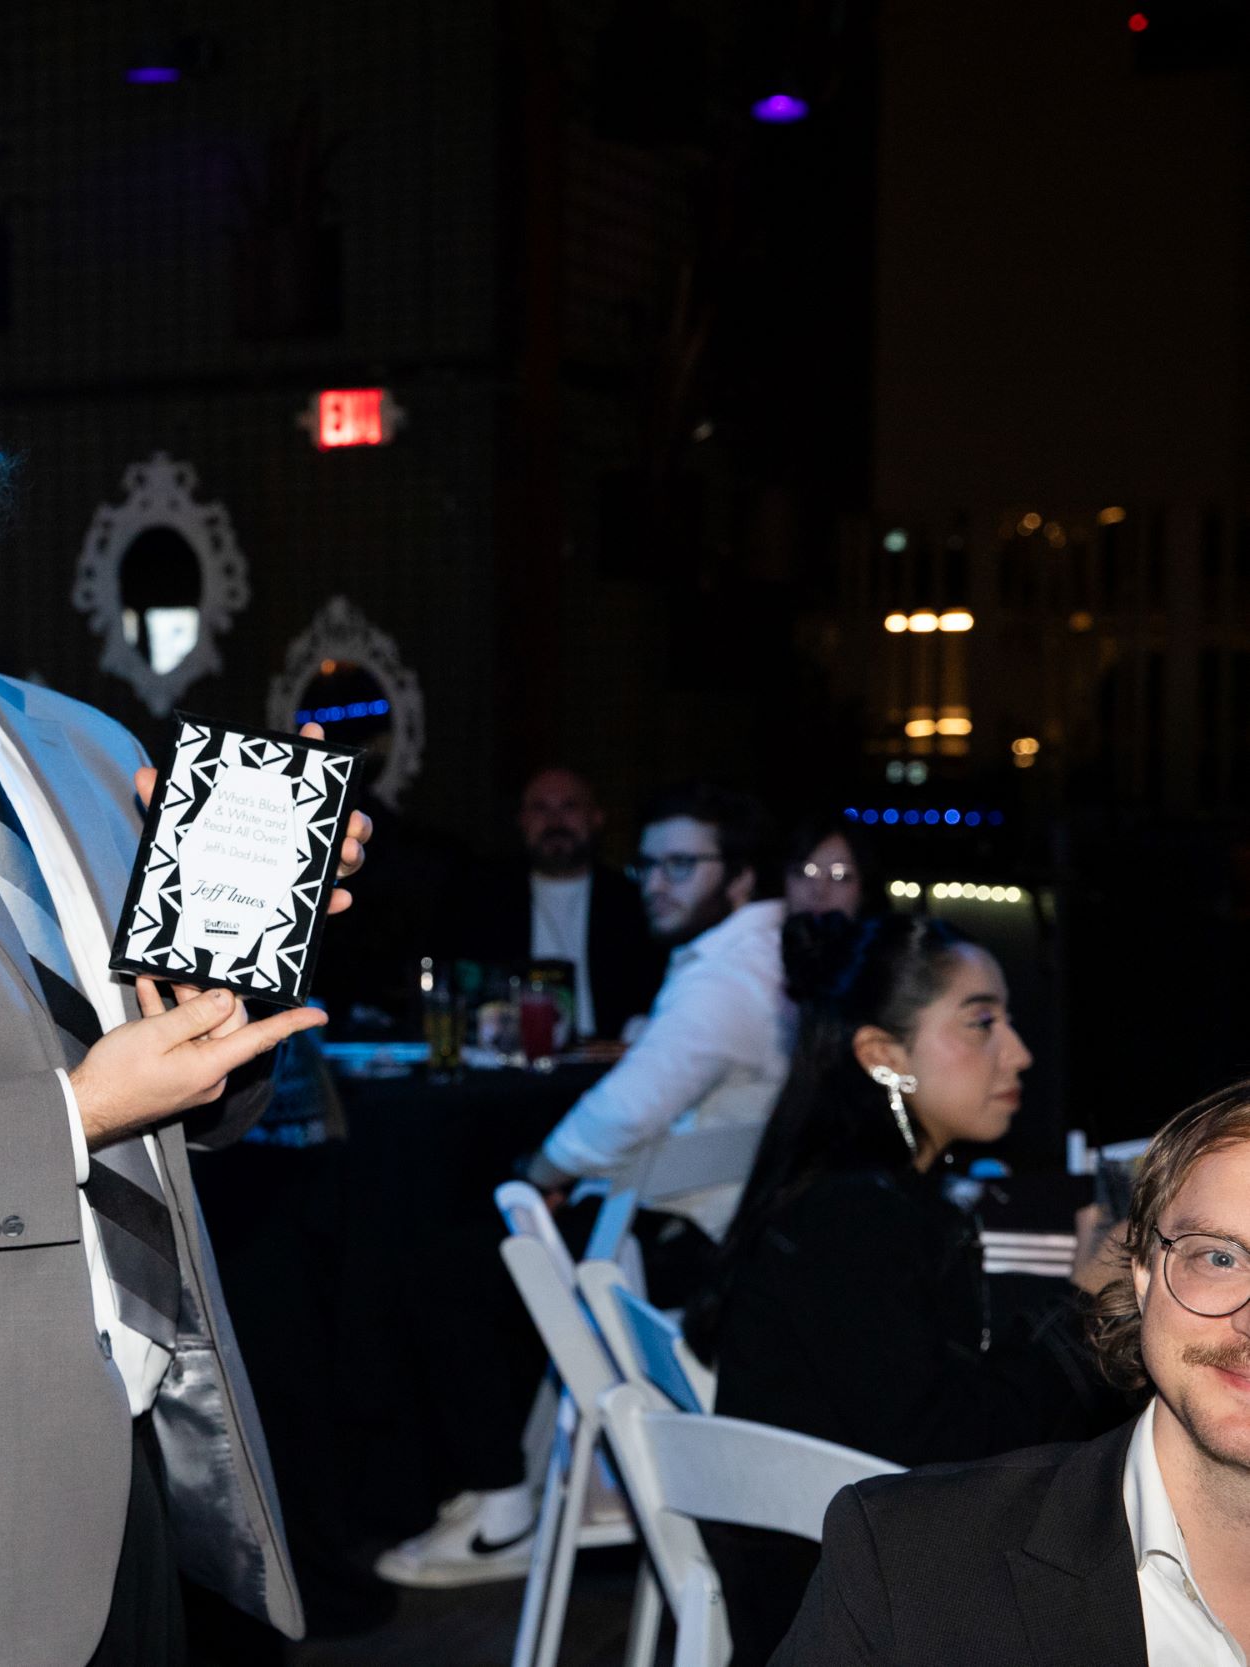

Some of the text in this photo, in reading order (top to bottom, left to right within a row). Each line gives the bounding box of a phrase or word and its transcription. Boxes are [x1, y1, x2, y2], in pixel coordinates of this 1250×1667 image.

[217, 789, 287, 814] What's Black
[214, 805, 287, 830] & White and
[202, 817, 288, 846] Read All Over?
[230, 846, 251, 861] Dad
[190, 879, 266, 910] Jeff Innes
